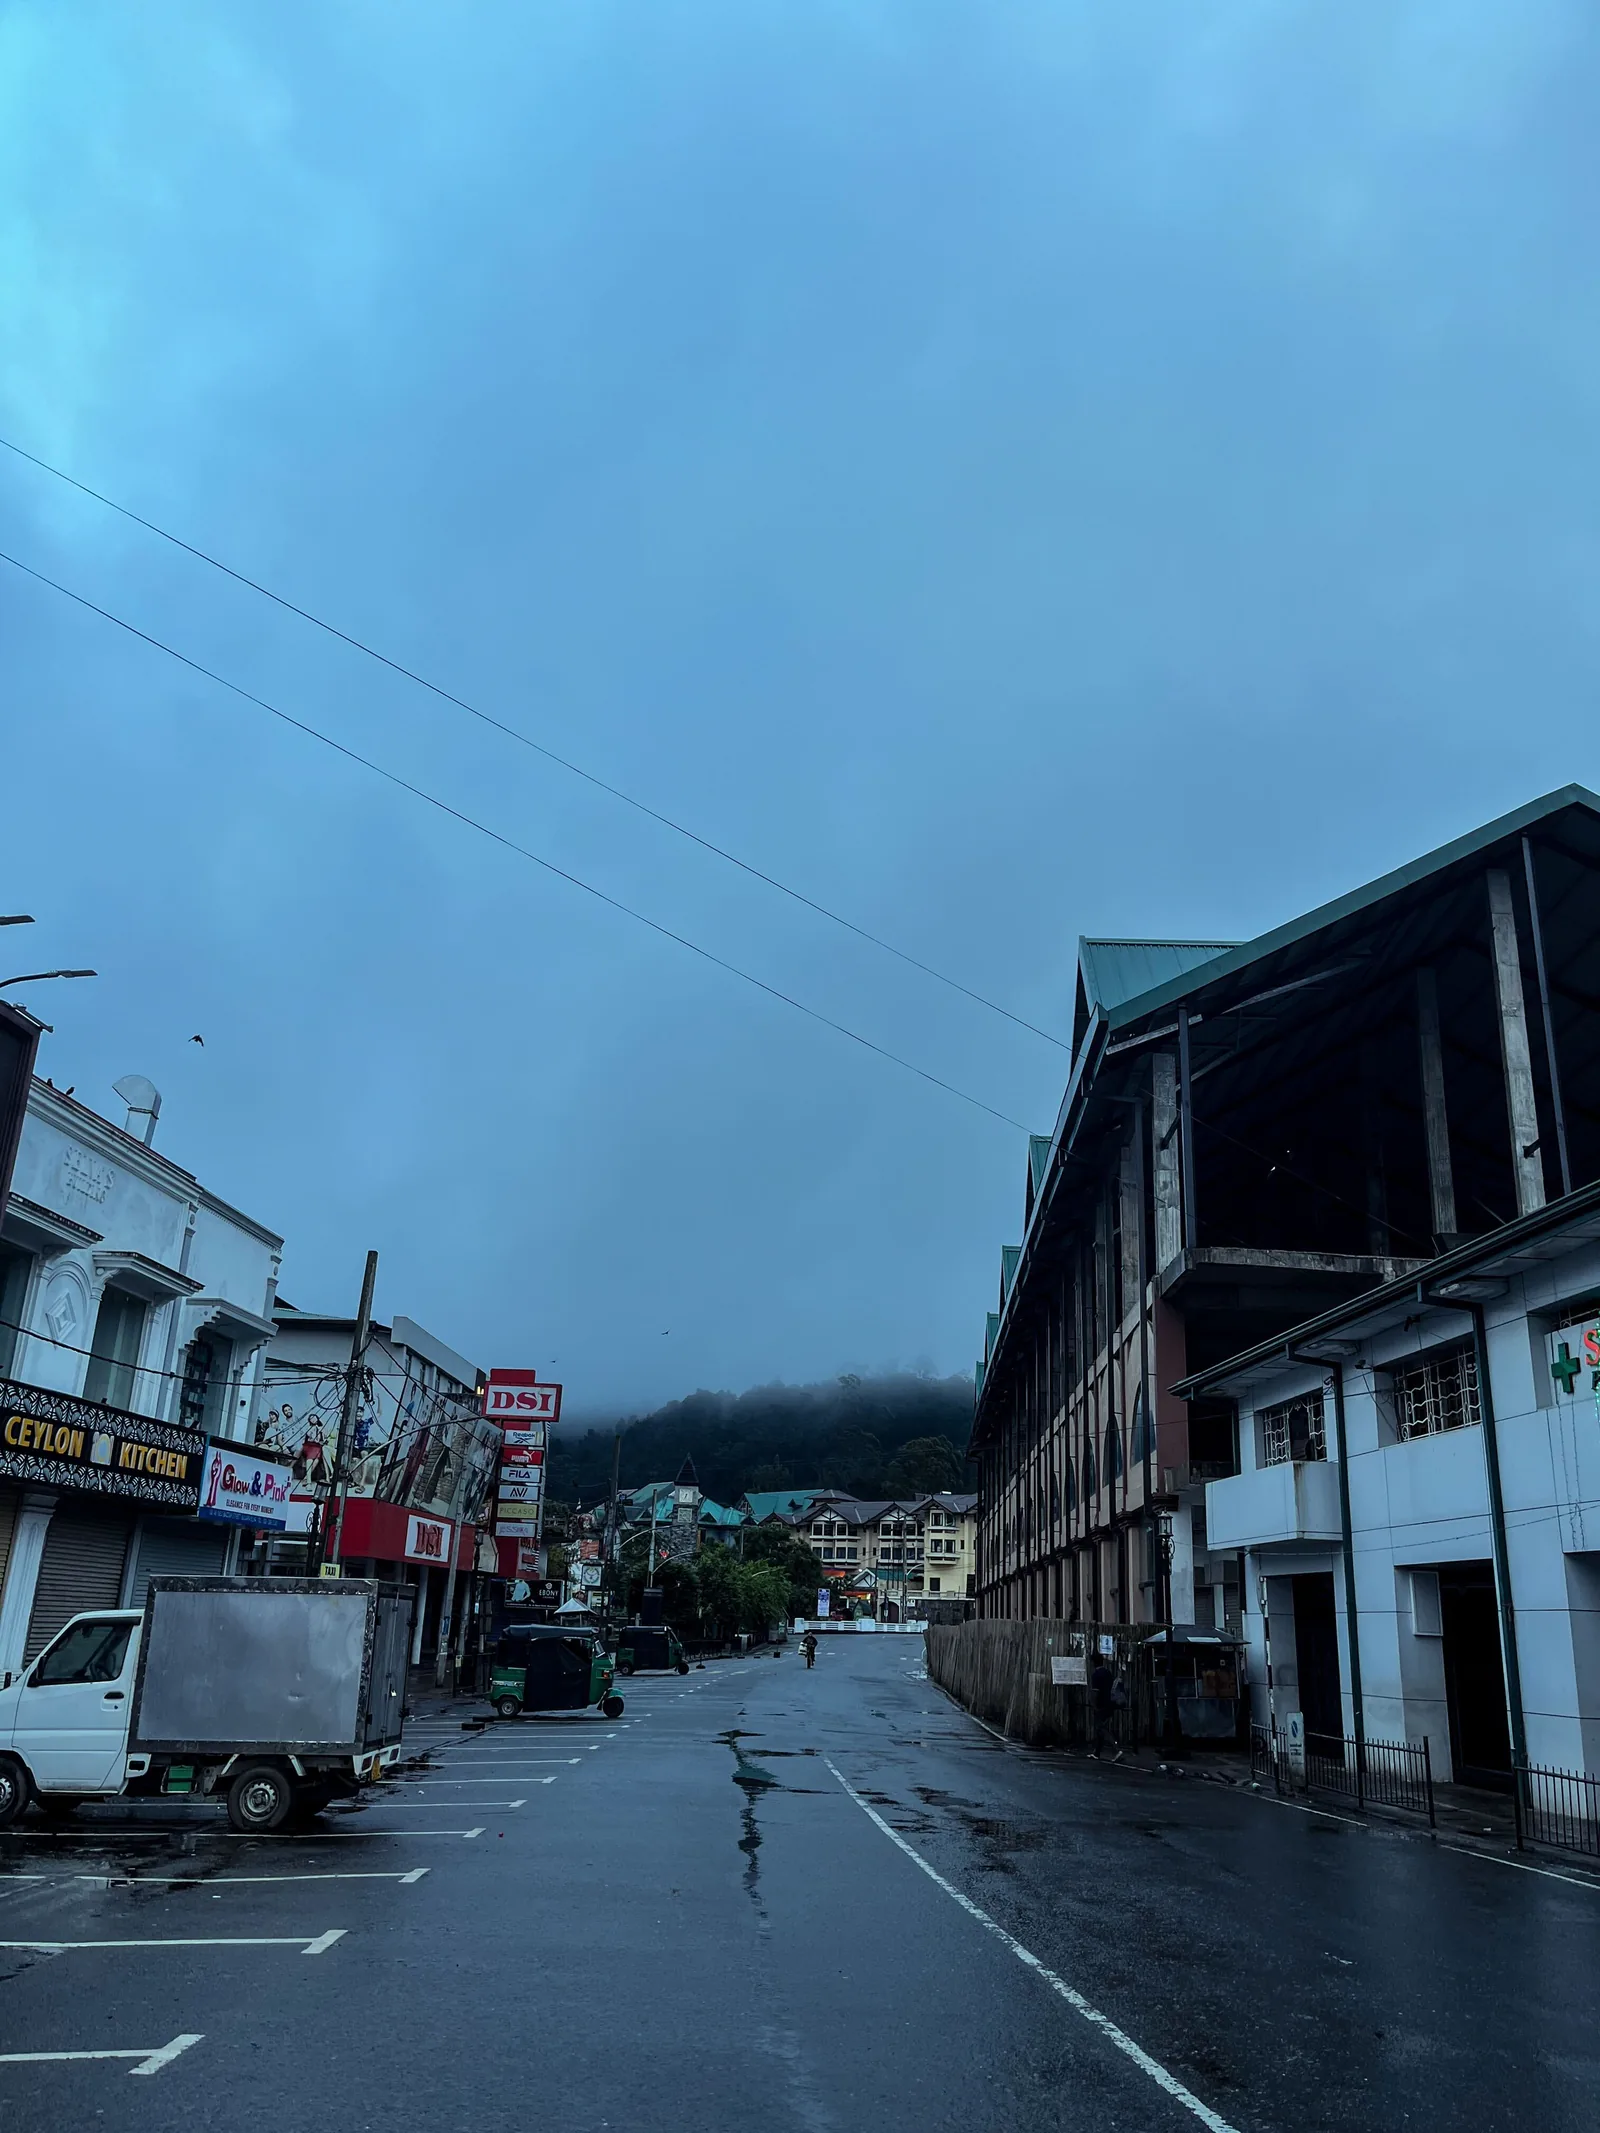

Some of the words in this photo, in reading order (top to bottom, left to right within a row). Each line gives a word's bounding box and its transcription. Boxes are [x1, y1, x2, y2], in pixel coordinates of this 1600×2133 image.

[491, 1391, 552, 1411] DSI
[5, 1415, 85, 1458] CEYLON
[119, 1441, 188, 1479] KITCHEN
[250, 1471, 263, 1497] &
[509, 1470, 530, 1478] FILA
[499, 1507, 535, 1515] PICCASO
[414, 1522, 445, 1557] DSI
[325, 1566, 337, 1576] TAXI
